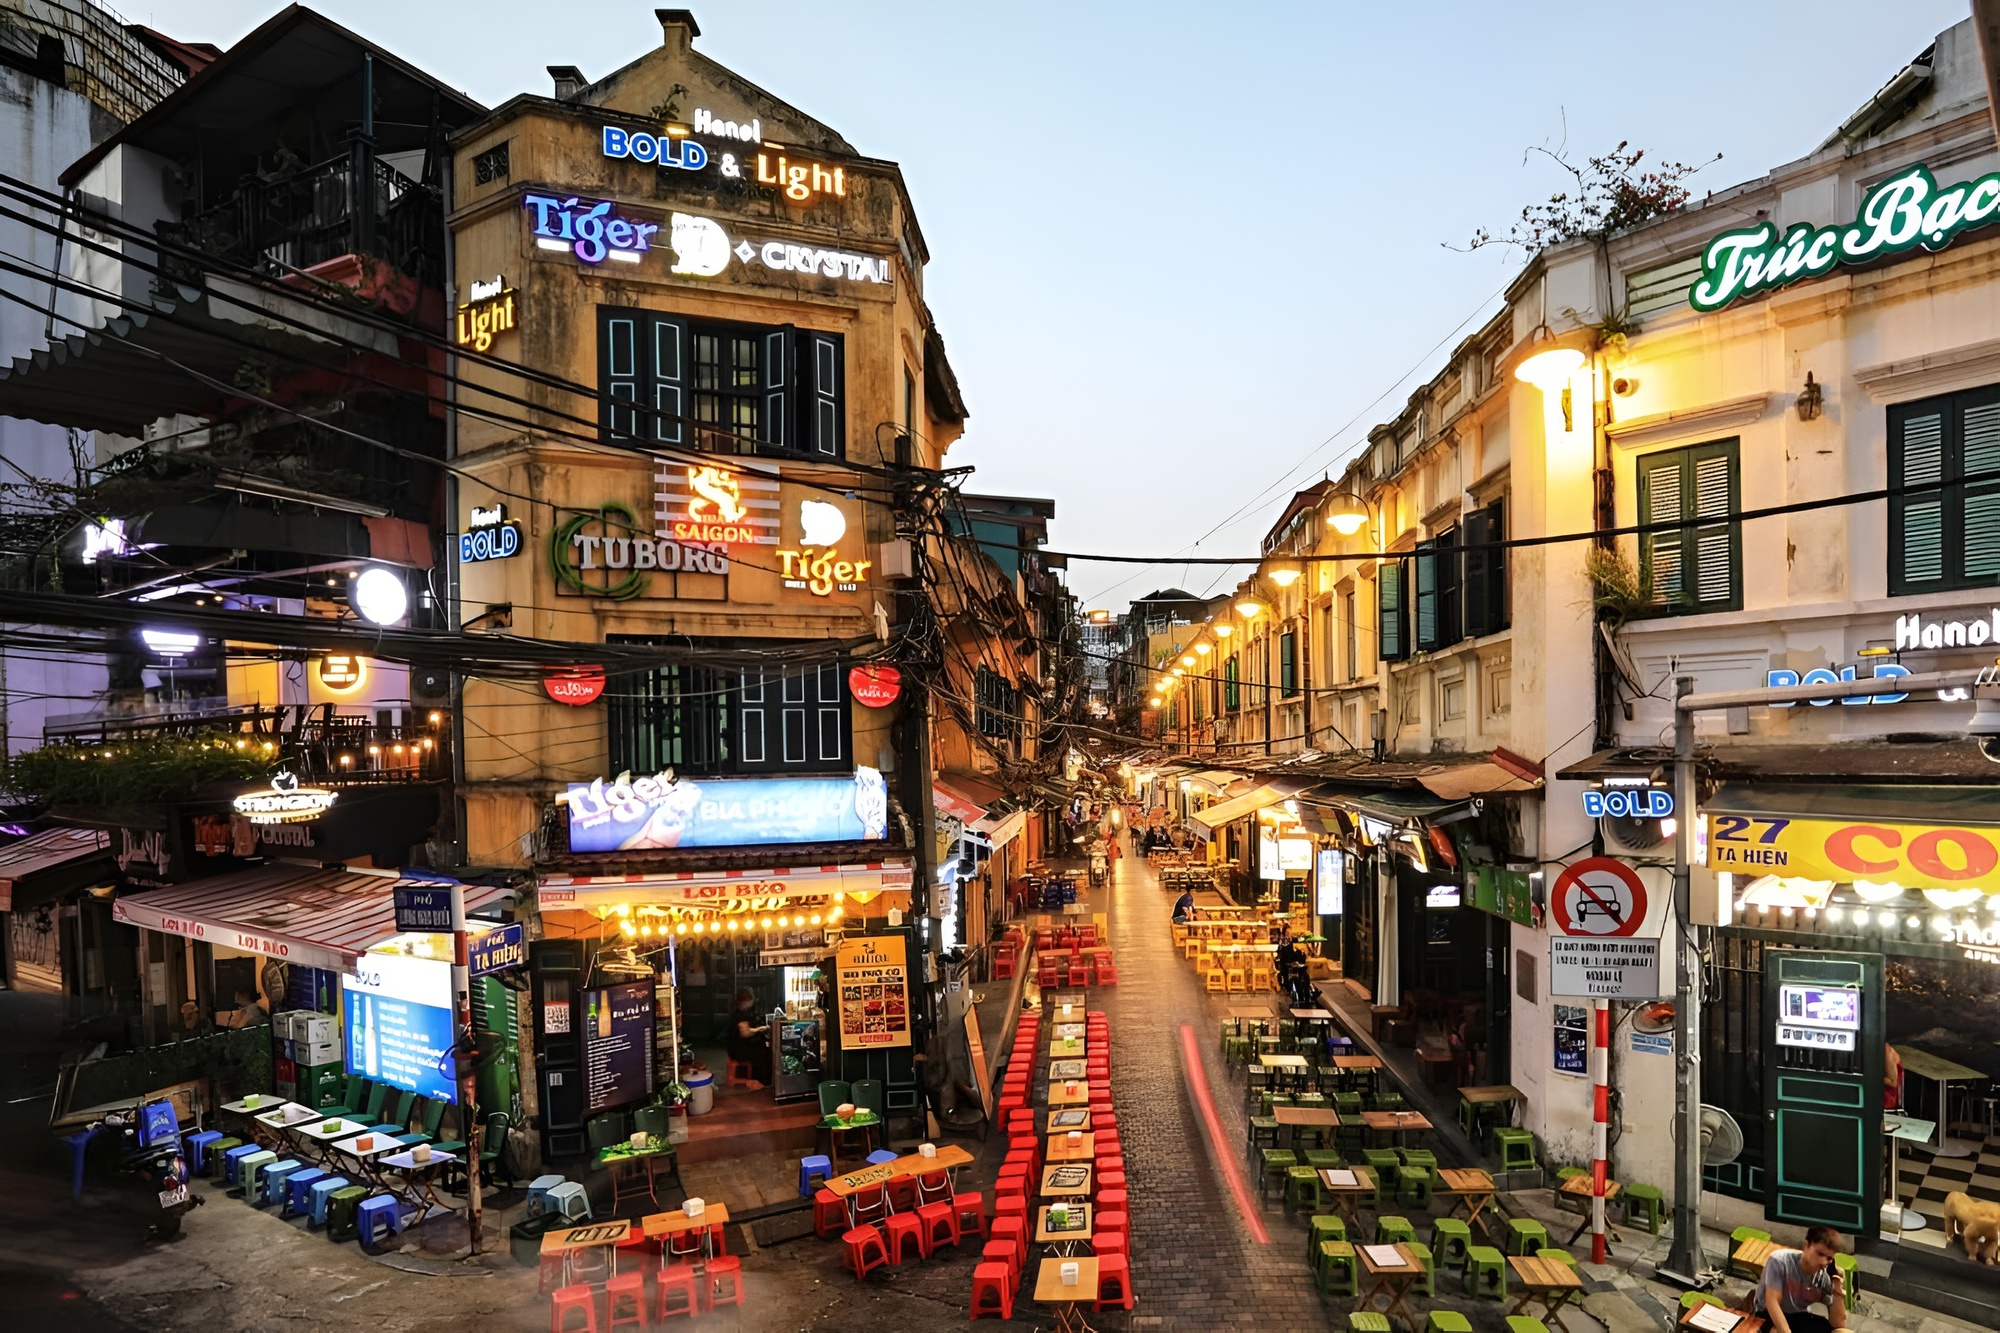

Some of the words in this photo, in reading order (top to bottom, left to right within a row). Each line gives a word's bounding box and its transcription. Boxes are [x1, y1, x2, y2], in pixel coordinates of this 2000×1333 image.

[602, 125, 708, 170] BOLD
[720, 153, 742, 178] &
[757, 153, 846, 201] Light
[525, 194, 658, 263] Tiger
[761, 242, 893, 284] CRYSTAL
[1695, 227, 1837, 305] Trúc
[458, 296, 514, 351] Light
[460, 526, 517, 563] BOLD
[573, 533, 729, 575] TUBORG
[674, 523, 754, 543] SAIGON
[775, 548, 872, 596] Tiger
[1582, 790, 1674, 818] BOLD
[1715, 815, 1791, 844] 27
